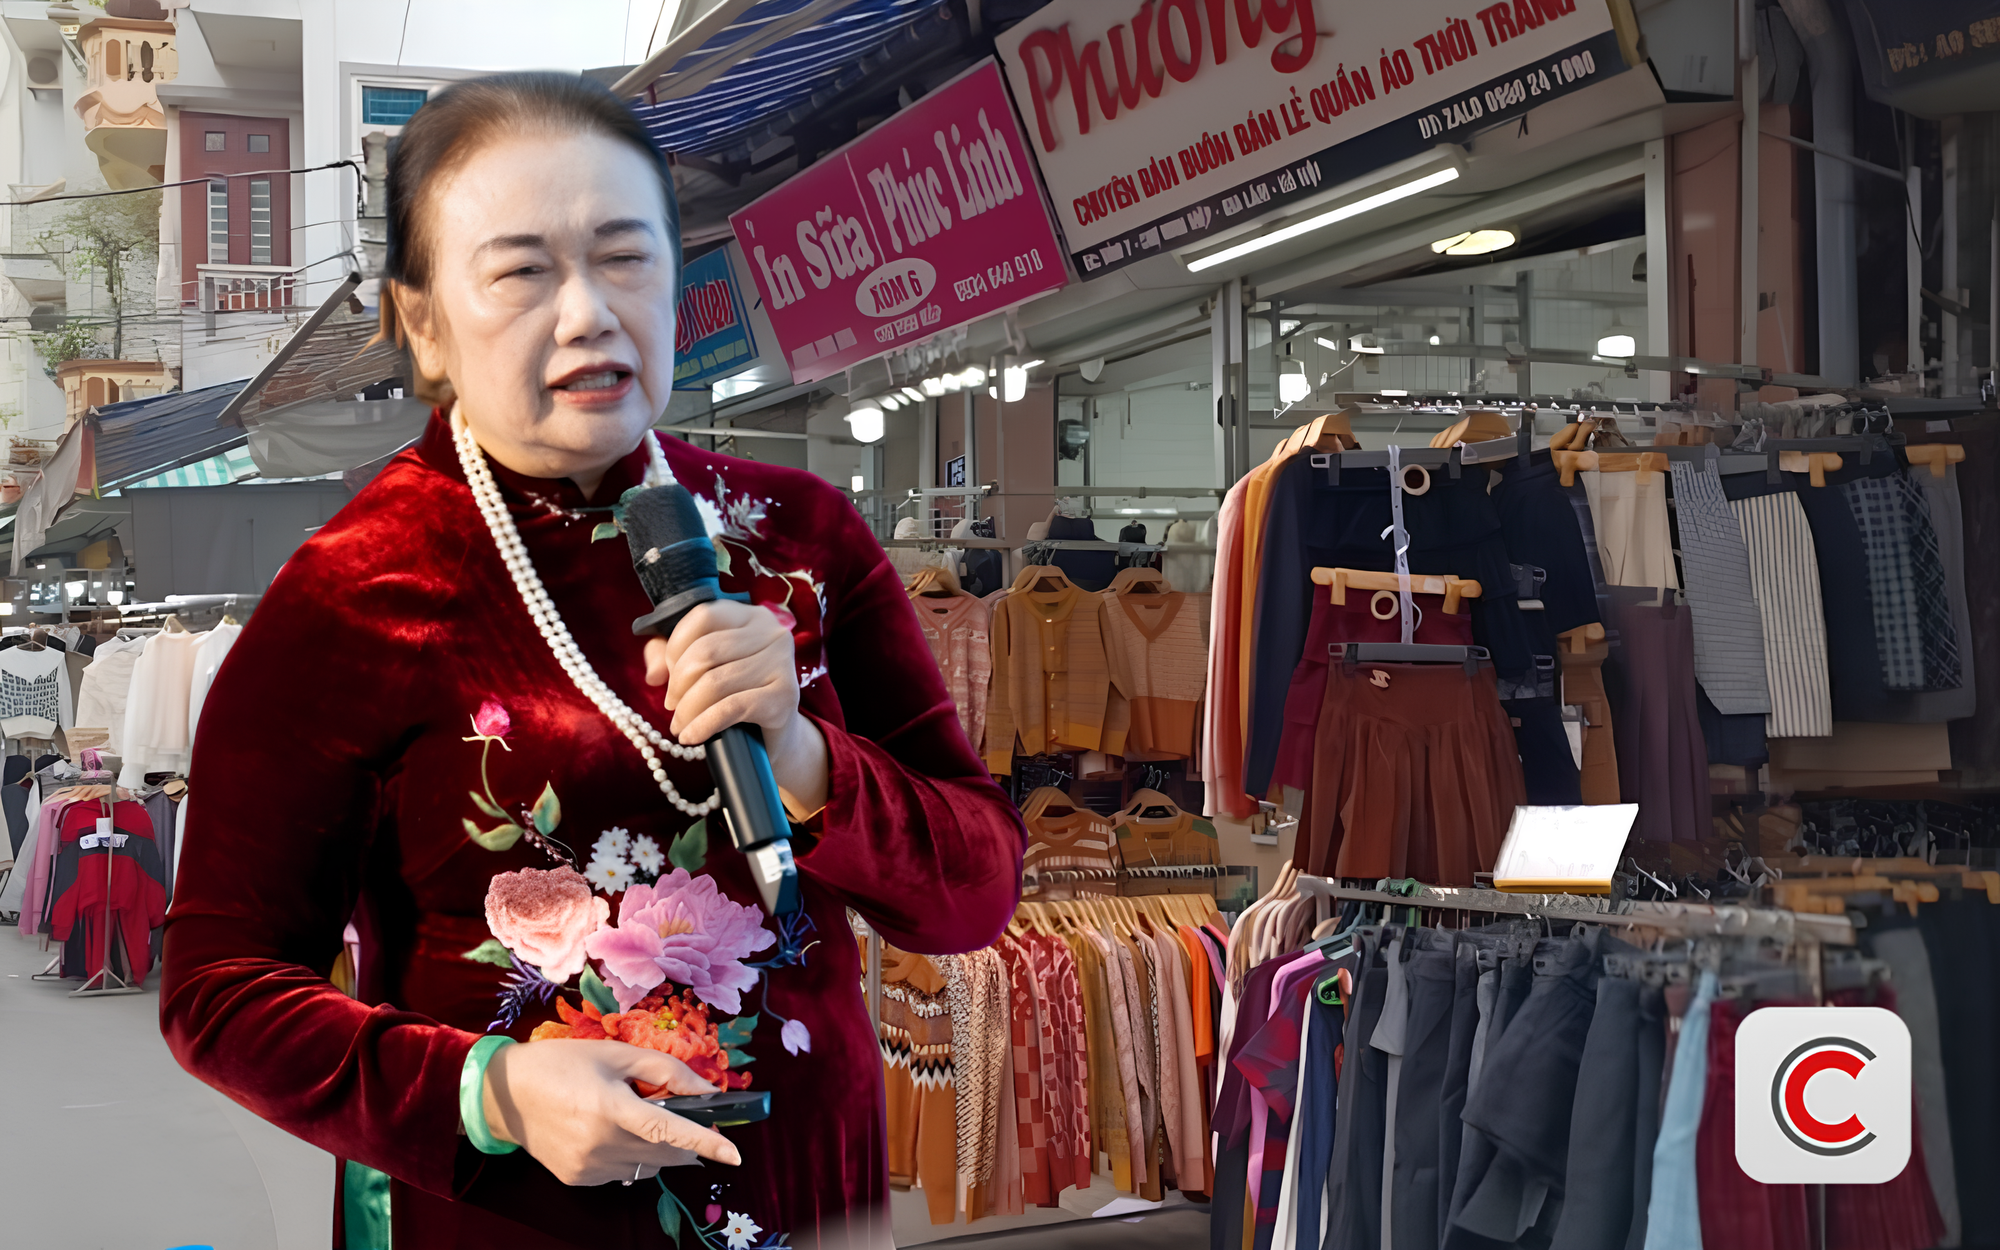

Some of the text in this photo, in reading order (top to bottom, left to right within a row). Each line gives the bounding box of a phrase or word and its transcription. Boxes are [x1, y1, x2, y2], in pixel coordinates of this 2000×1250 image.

[1232, 110, 1282, 156] BÁN
[1379, 47, 1415, 95] ÁO
[1441, 96, 1483, 130] ZALO
[796, 204, 875, 290] Sữa
[867, 147, 952, 254] Phúc
[934, 107, 1024, 220] Linh
[907, 269, 923, 298] 6
